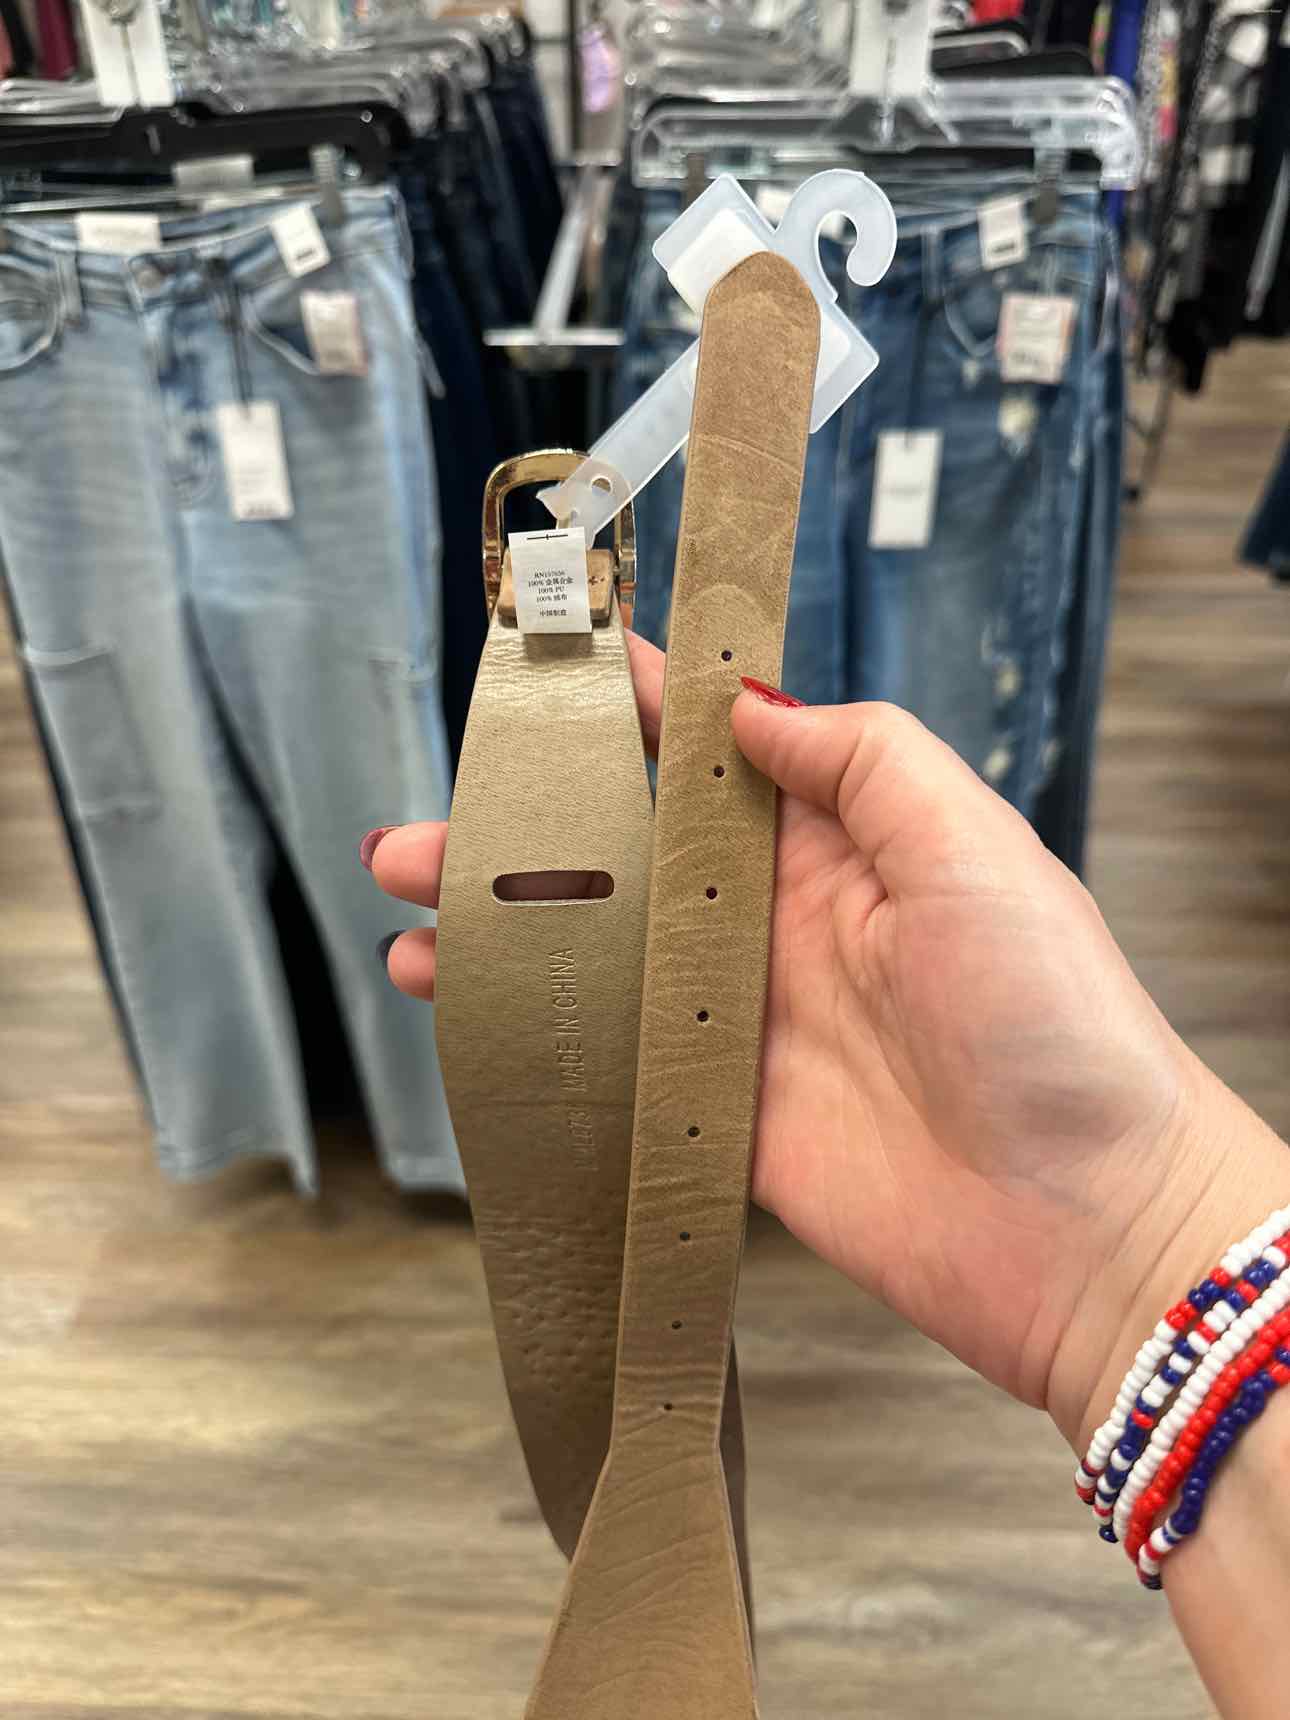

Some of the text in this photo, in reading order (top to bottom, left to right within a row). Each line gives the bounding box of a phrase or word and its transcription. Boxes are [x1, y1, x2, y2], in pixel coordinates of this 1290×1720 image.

[528, 579, 544, 587] 100%
[538, 585, 565, 594] 100% PU
[537, 595, 552, 603] 100%
[539, 608, 568, 617] 中国制造
[548, 948, 579, 1010] CHINA
[552, 1017, 581, 1036] IN
[557, 1041, 586, 1093] MADE
